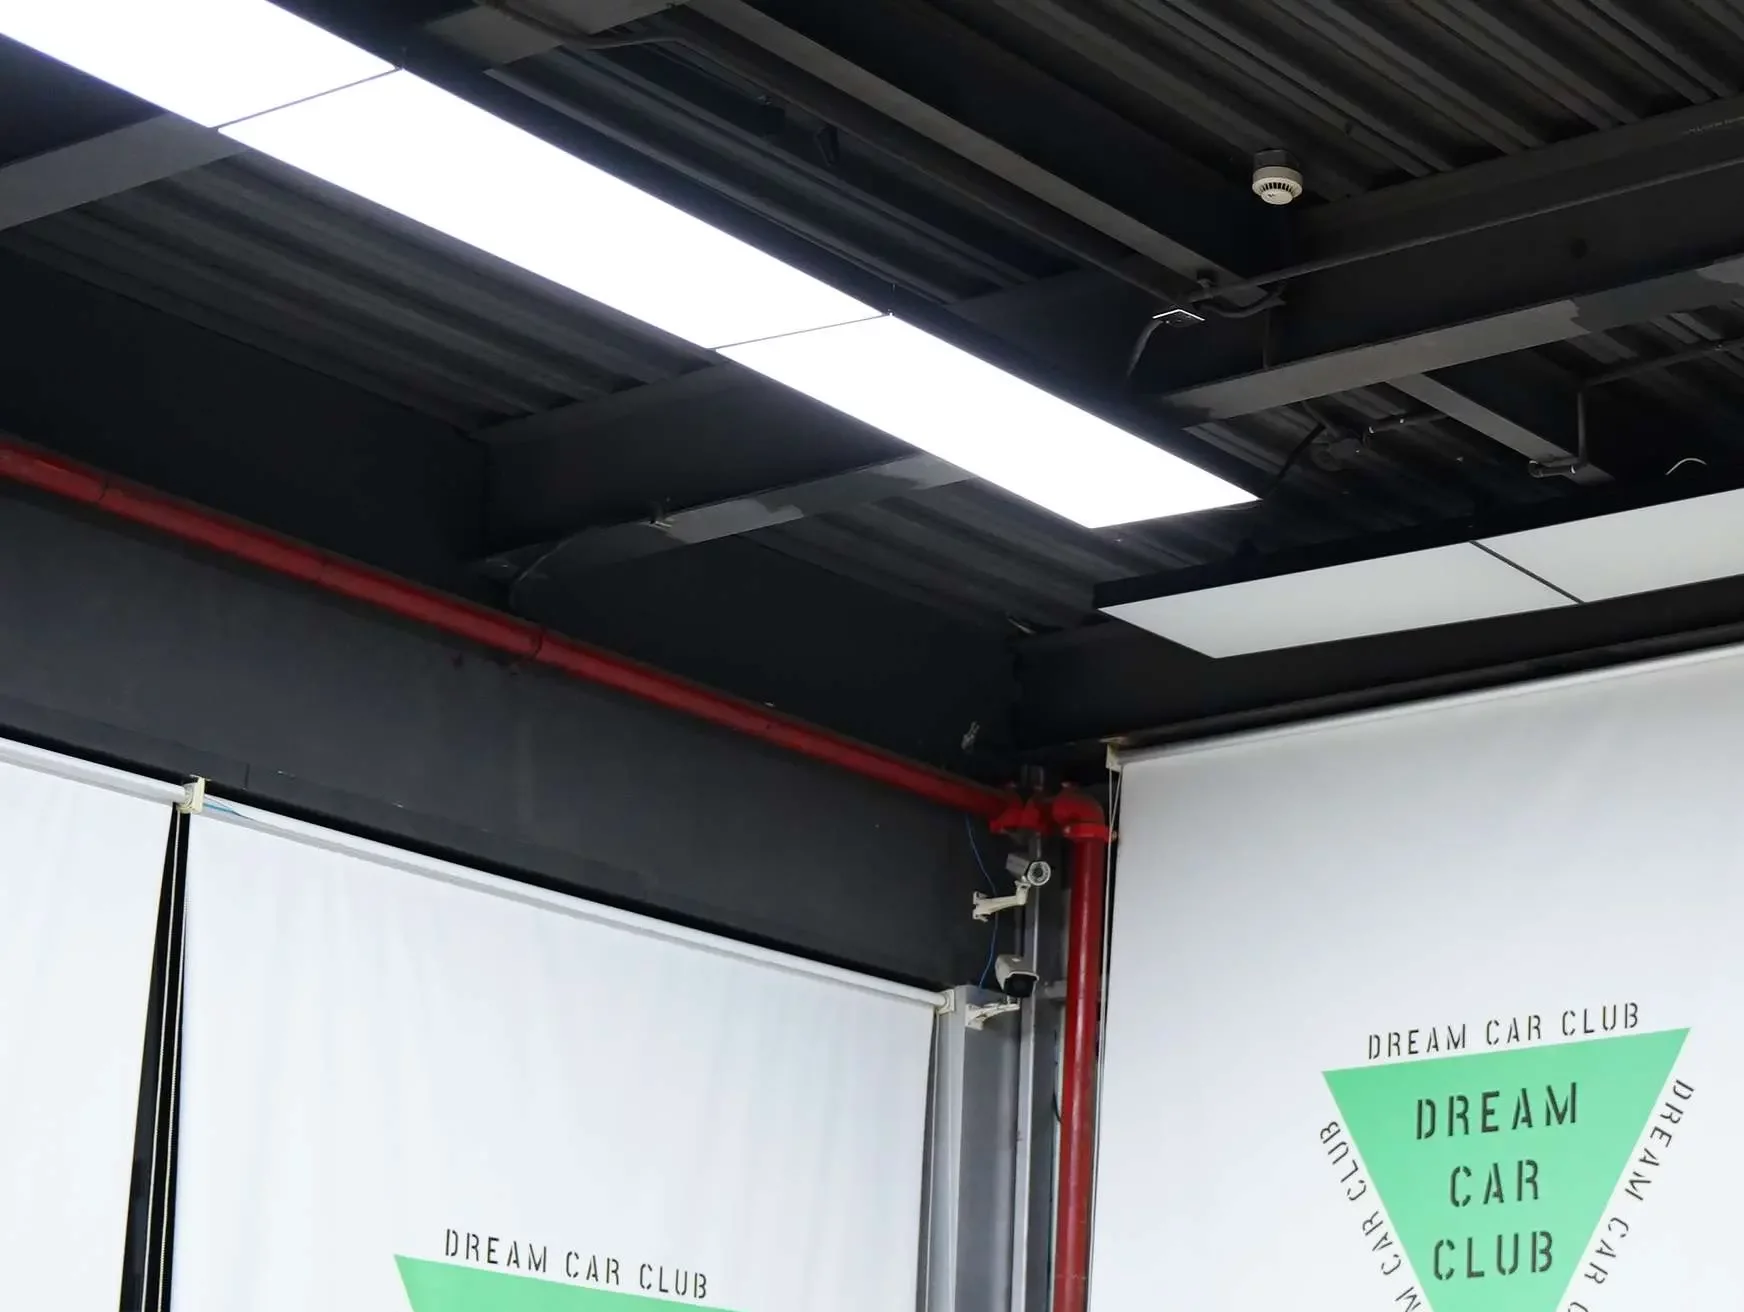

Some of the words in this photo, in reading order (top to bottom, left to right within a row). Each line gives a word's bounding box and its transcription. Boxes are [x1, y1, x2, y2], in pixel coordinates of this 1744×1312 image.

[1368, 1023, 1466, 1060] DREAM
[1486, 1014, 1542, 1047] CAR
[1562, 1002, 1639, 1036] CLUB
[1416, 1081, 1577, 1140] DREAM
[1625, 1079, 1695, 1201] DREAM
[1319, 1120, 1367, 1202] CLUB
[1450, 1158, 1539, 1208] CAR
[444, 1229, 548, 1275] DREAM
[565, 1250, 620, 1285] CAR
[639, 1263, 708, 1300] CLUB
[1361, 1211, 1402, 1276] CAR
[1434, 1230, 1553, 1281] CLUB
[1584, 1216, 1629, 1285] CAR
